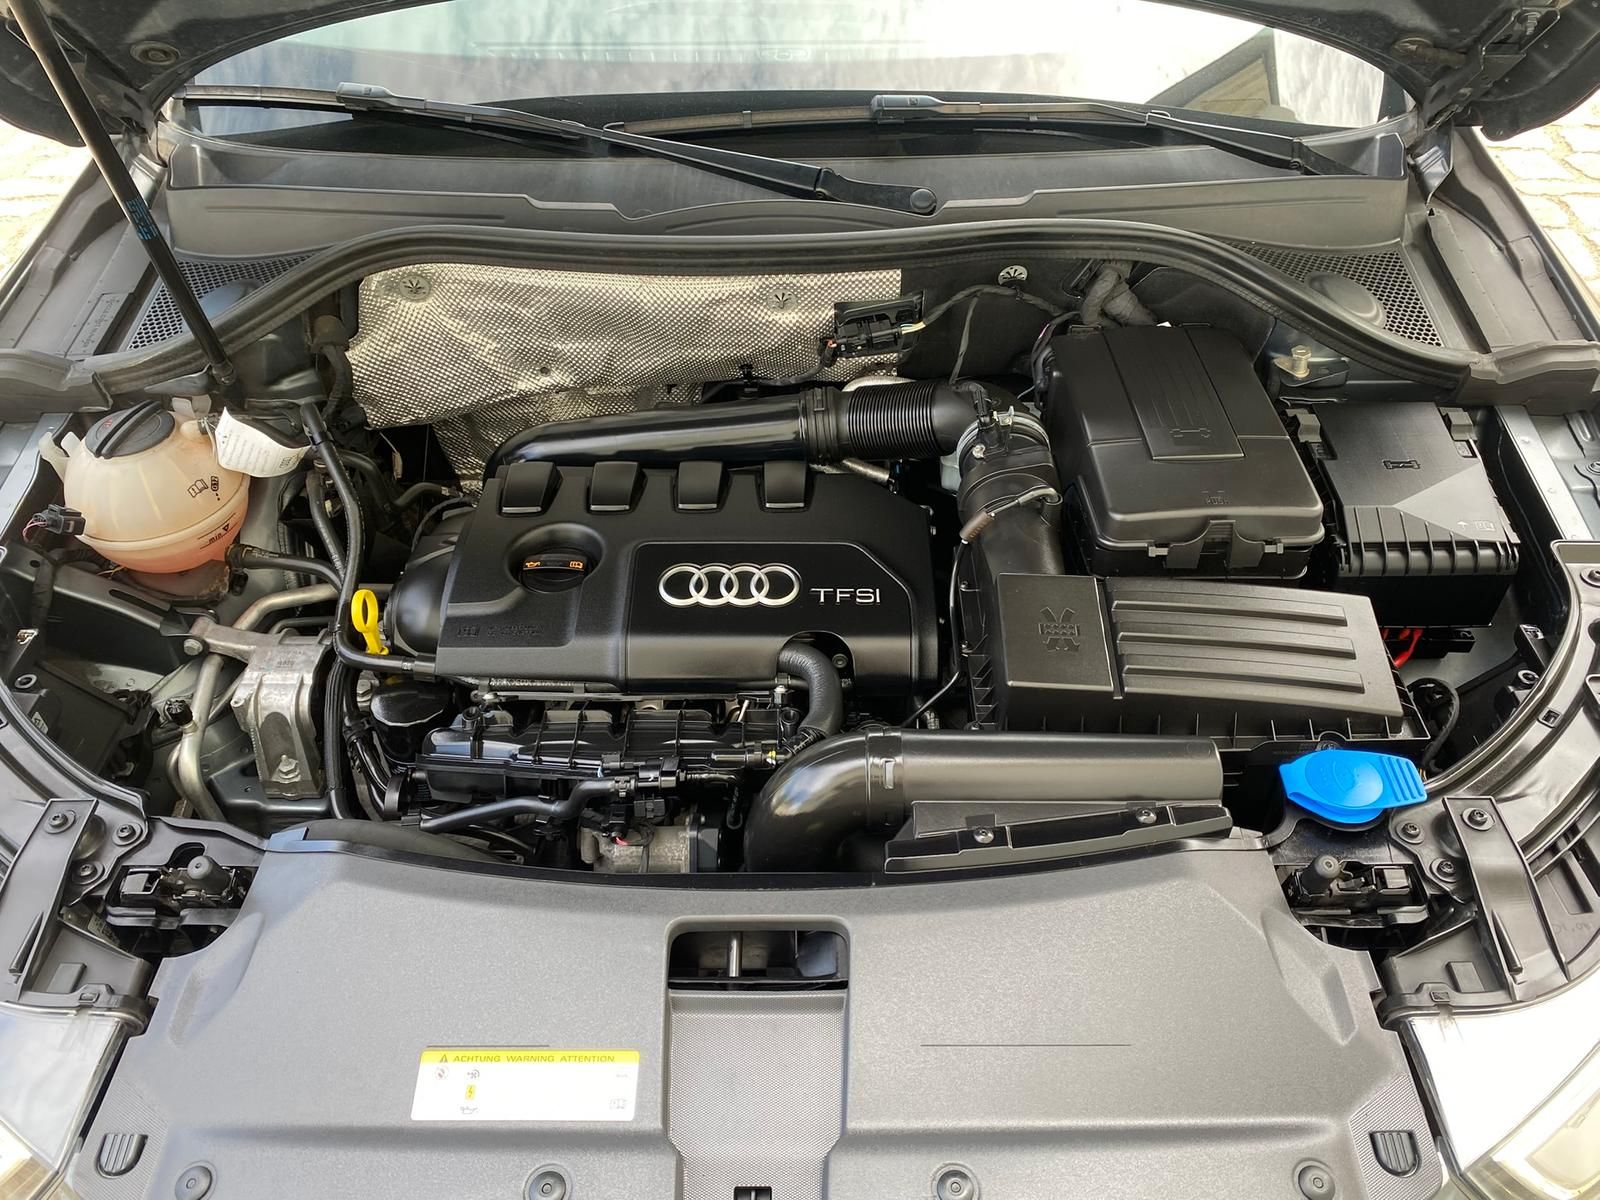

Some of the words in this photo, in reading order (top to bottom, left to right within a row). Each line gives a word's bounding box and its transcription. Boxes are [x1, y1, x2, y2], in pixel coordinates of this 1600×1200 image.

[208, 532, 222, 544] min
[810, 588, 881, 604] TFSI
[453, 1054, 501, 1063] ACHTUNG
[506, 1054, 555, 1063] WARNING
[560, 1054, 615, 1063] ATTENTION
